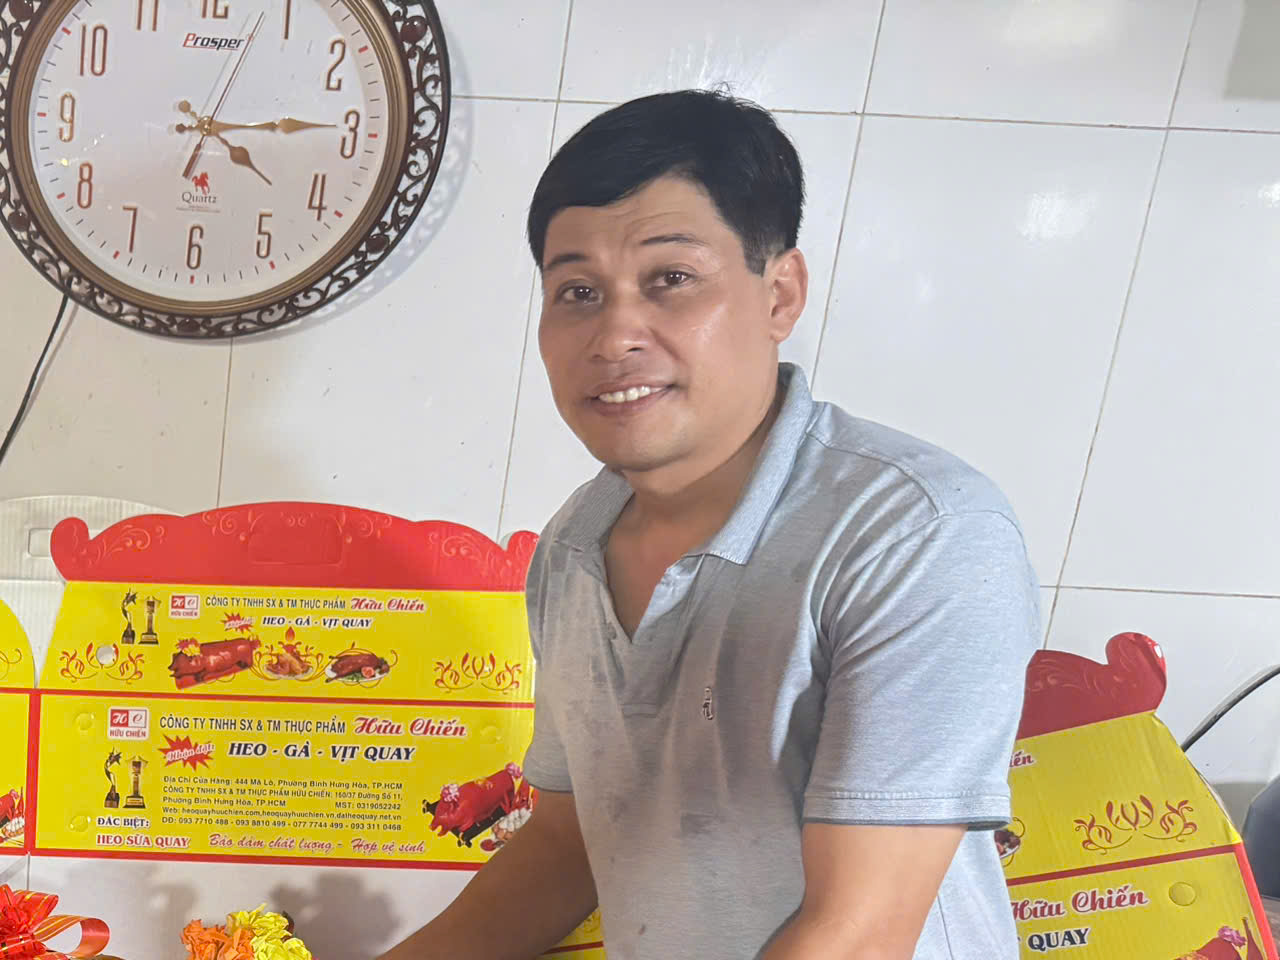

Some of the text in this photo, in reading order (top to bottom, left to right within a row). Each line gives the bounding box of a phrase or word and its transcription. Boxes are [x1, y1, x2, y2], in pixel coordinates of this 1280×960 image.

[79, 24, 108, 76] 10
[183, 32, 245, 51] Prosper
[326, 38, 346, 91] 2
[59, 92, 76, 142] 9
[340, 110, 361, 159] 3
[77, 162, 93, 209] 8
[181, 191, 217, 205] Quartz
[307, 174, 327, 222] 4
[122, 206, 138, 253] 7
[187, 225, 203, 270] 6
[255, 211, 272, 259] 5
[160, 714, 466, 736] CÔNG TY TNHH SX TM THỰC PHẨM Hữu Chiến
[228, 741, 415, 762] HEO GÀ VỊT QUAY
[97, 834, 189, 847] HEO SỮA QUAY
[1072, 885, 1149, 913] Chiến
[1028, 927, 1089, 952] QUAY
